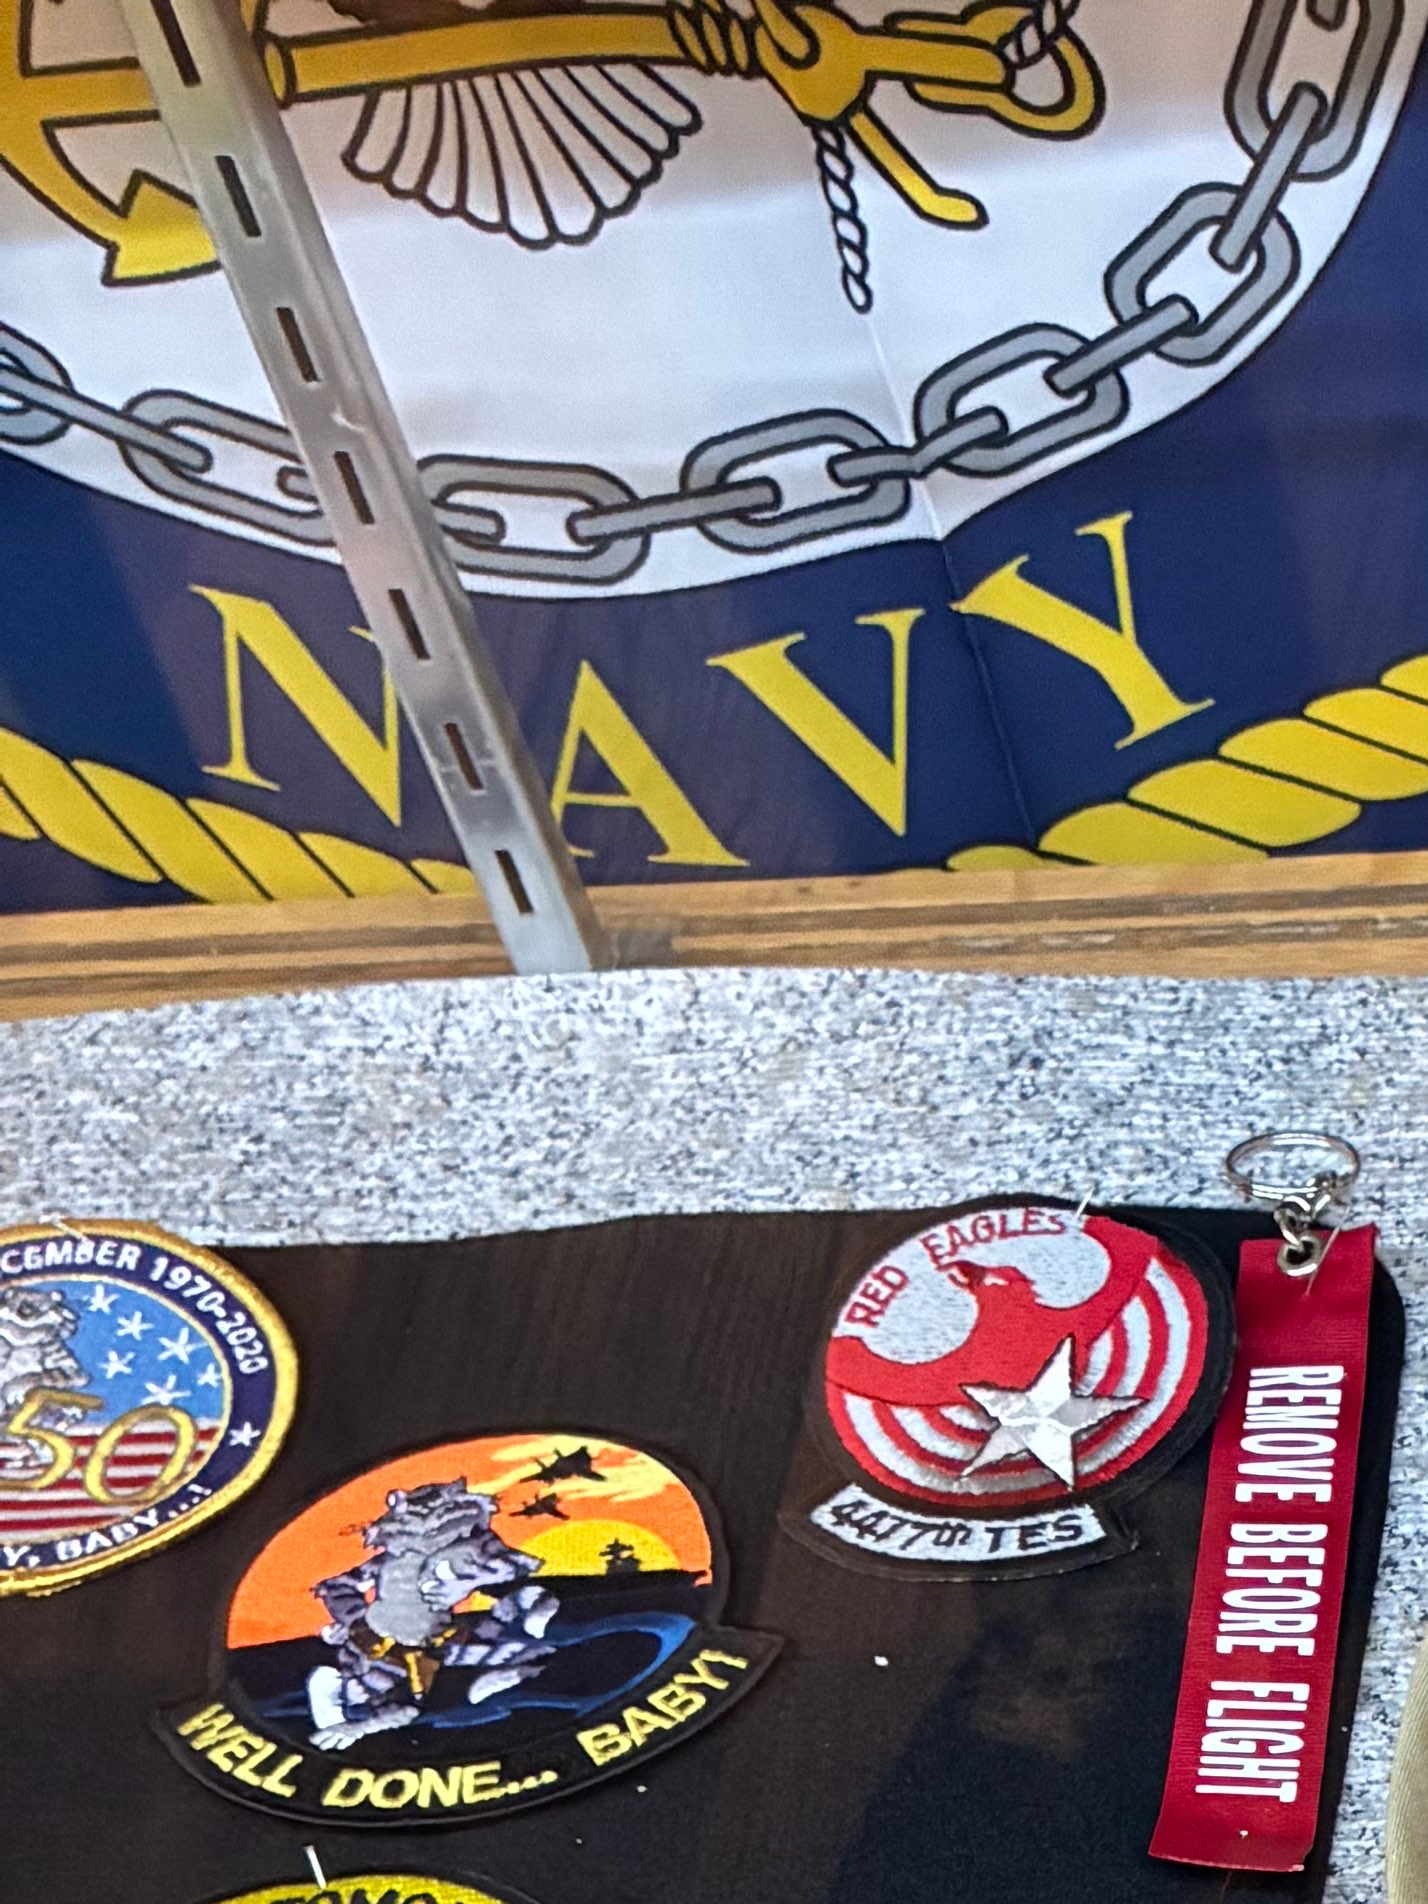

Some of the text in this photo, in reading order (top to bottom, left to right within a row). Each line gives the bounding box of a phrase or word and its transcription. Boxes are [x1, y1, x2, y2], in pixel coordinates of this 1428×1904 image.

[190, 510, 1216, 868] NAVY
[150, 1257, 269, 1375] 1970-2020
[844, 1207, 1068, 1328] RED EAGLES
[0, 1384, 198, 1507] 50
[985, 1513, 1083, 1552] TES
[1195, 1364, 1345, 1803] REMOVE BEFORE FLIGHT
[176, 1703, 302, 1798] WELL
[322, 1759, 558, 1810] DONE...
